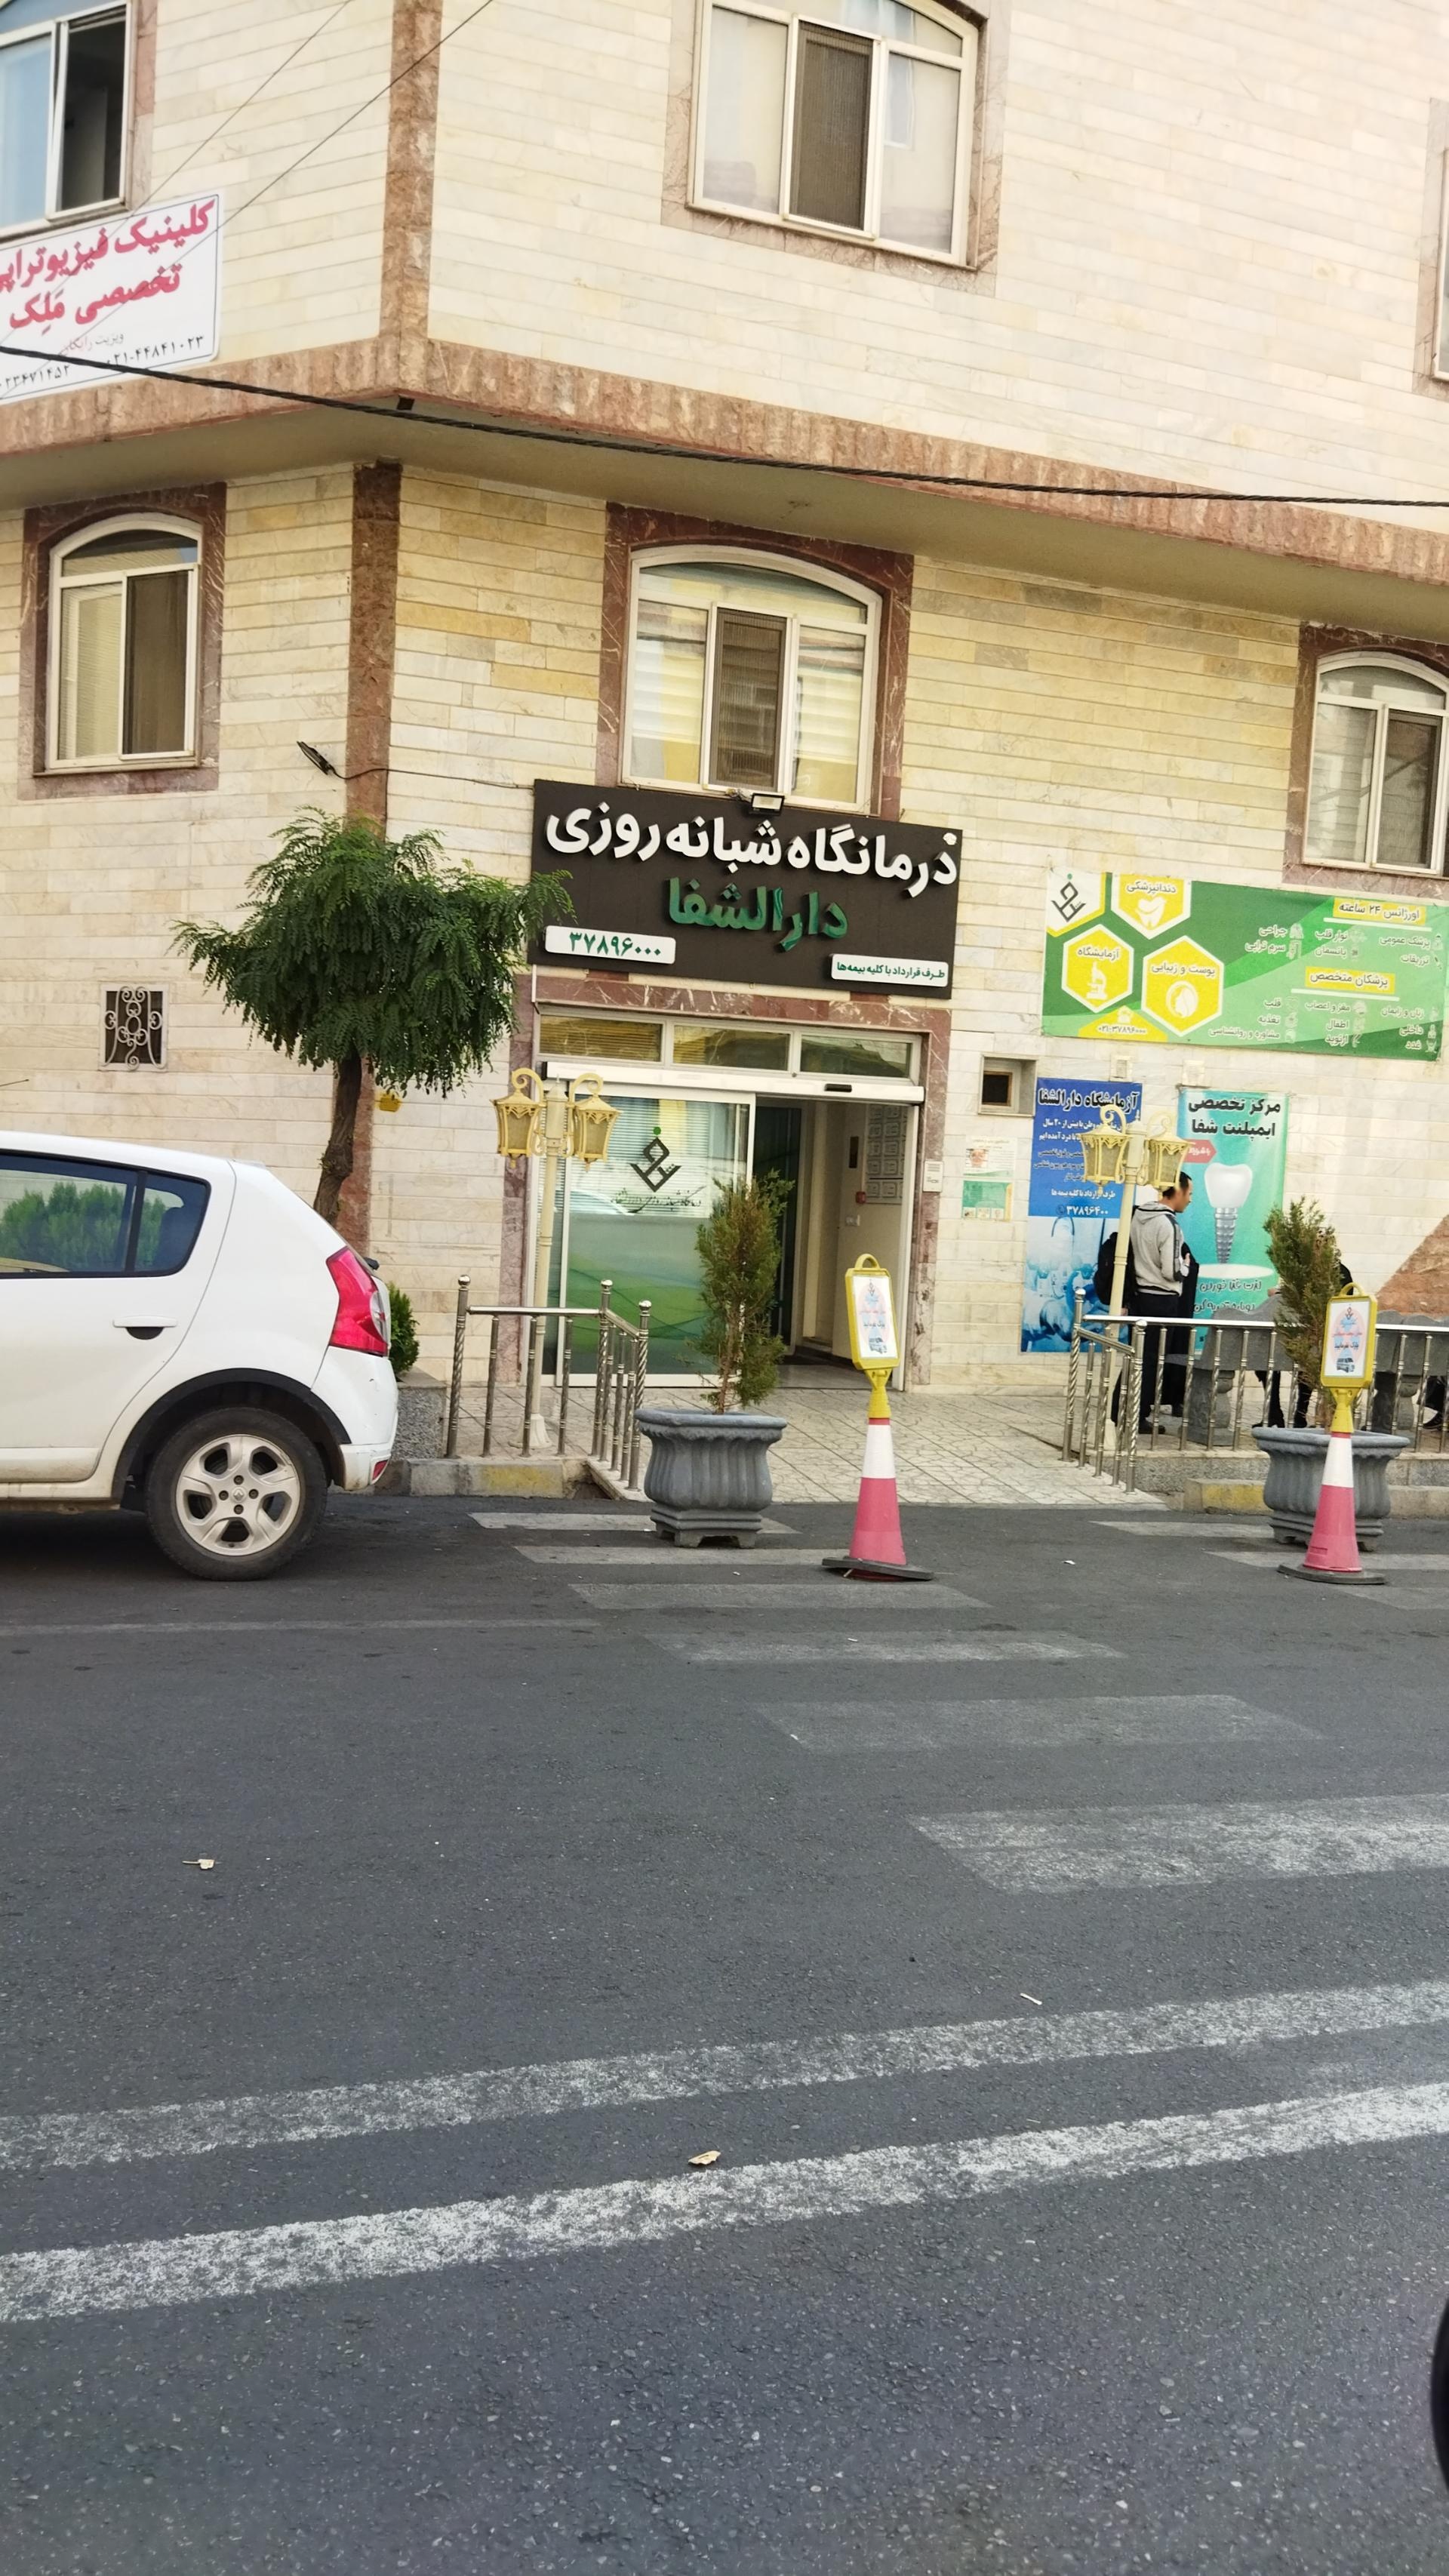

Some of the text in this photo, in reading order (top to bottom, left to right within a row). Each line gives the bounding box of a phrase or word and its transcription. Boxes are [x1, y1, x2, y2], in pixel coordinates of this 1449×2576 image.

[0, 199, 215, 293] کلینیک فیزیوتراپ
[75, 263, 183, 325] تخصصی
[546, 801, 958, 898] درمانگاه شبانه روزی
[1127, 881, 1177, 894] دندانپزشکی
[1338, 903, 1420, 922] اورژانس ۲۴ ساعته
[1258, 925, 1287, 937] جراحی
[1315, 930, 1348, 943] نوار قلب
[569, 930, 662, 958] ۳۷۸۹۶۰۰۰
[1244, 940, 1286, 954] سرم تراپی
[1379, 936, 1430, 949] پزشک عمومی
[1077, 946, 1121, 962] آزمایشگاه
[866, 964, 884, 975] کلیه
[885, 965, 892, 976] با
[893, 965, 921, 978] قرارداد
[1151, 962, 1216, 978] پوست و زیبایی
[1310, 971, 1389, 988] پزشکان متخصص
[1263, 996, 1282, 1008] قلب
[1257, 1014, 1281, 1026] تغذیه
[1326, 1018, 1349, 1030] اطفال
[1209, 1026, 1247, 1038] روانشناسی
[1254, 1029, 1281, 1041] مشاوره
[1399, 1023, 1424, 1036] داخلی
[1404, 1039, 1423, 1050] غدد
[1084, 1091, 1140, 1114] آزمایشگاه
[1189, 1097, 1281, 1116] مرکز تخصصی
[1192, 1119, 1275, 1142] ایمپلنت شفا
[1198, 1278, 1262, 1293] لذت غذا خوردن
